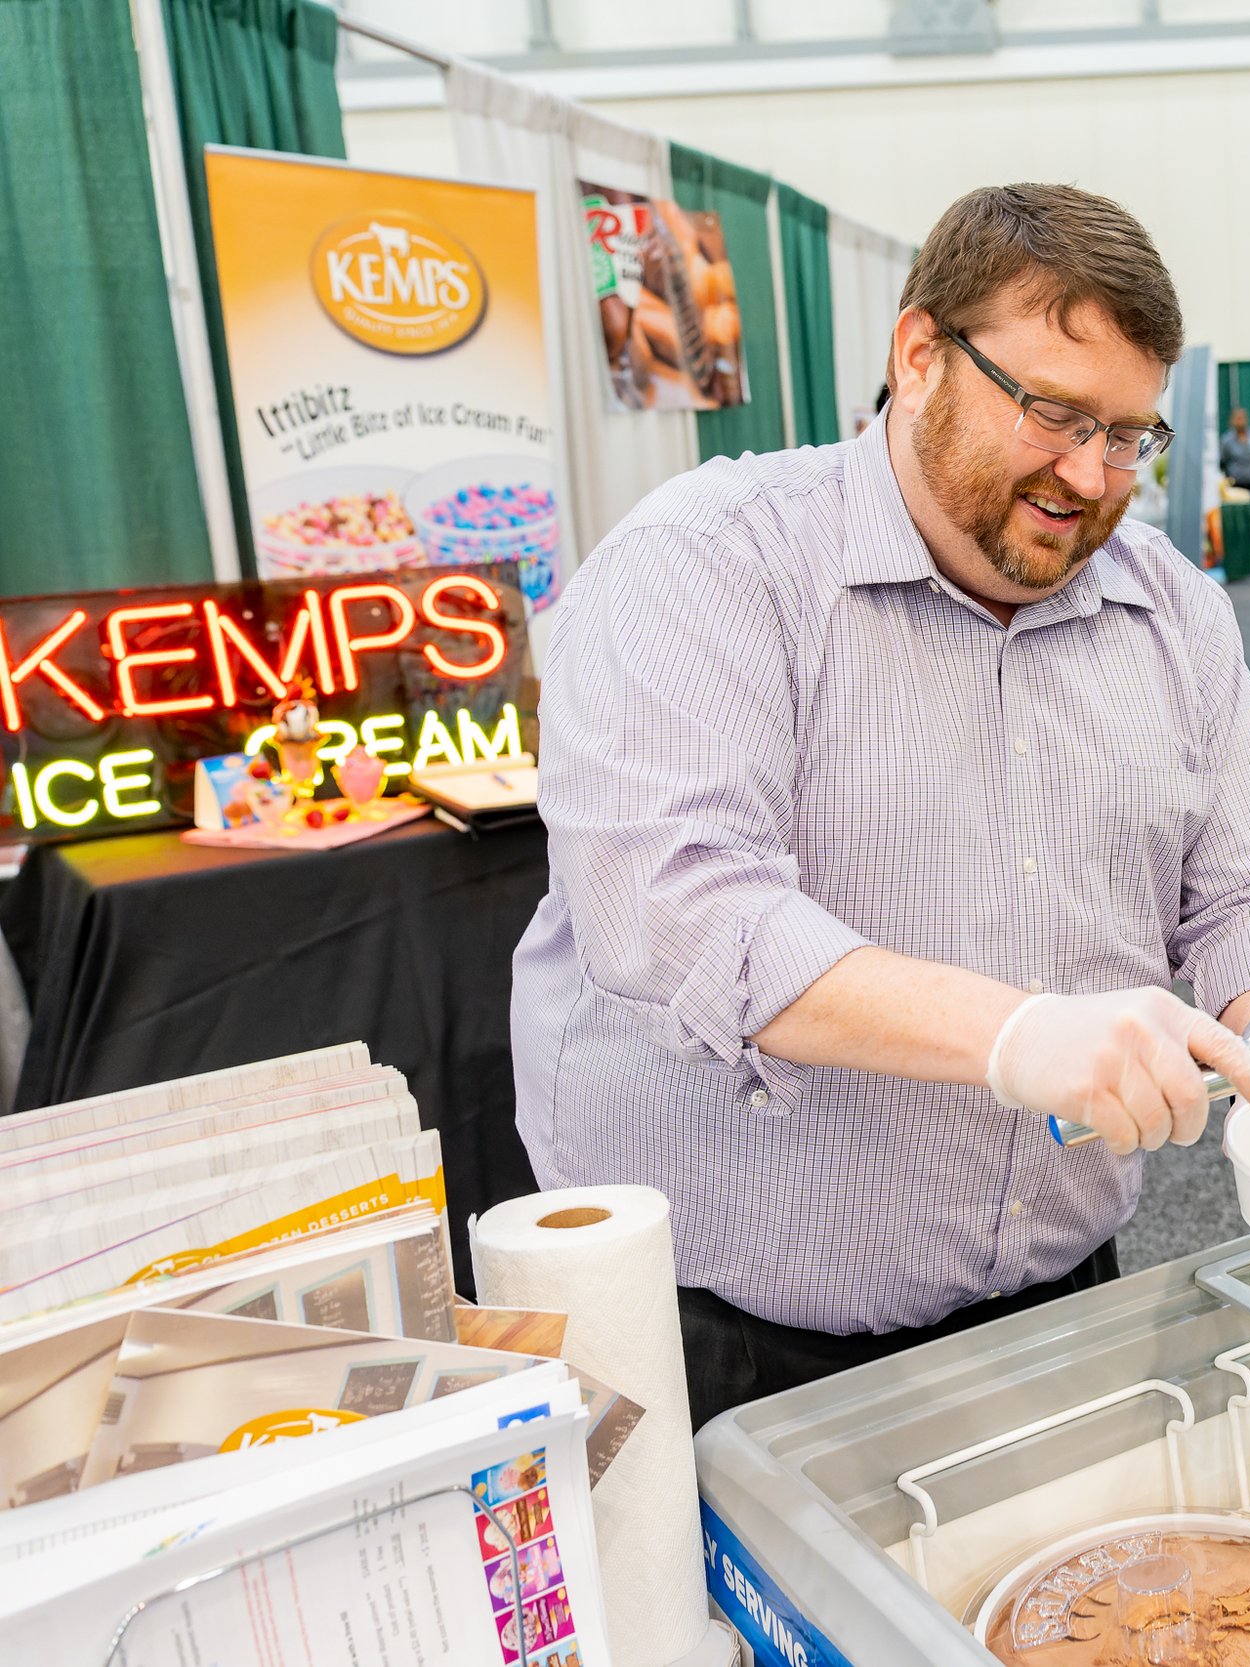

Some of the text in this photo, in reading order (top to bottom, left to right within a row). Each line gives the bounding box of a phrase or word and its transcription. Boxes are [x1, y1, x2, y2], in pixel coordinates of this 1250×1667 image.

[326, 248, 470, 311] KEMPS
[393, 403, 412, 428] of
[417, 404, 448, 427] Ice
[450, 402, 511, 434] Cream
[0, 573, 507, 732] KEMPS
[11, 748, 163, 830] ICE
[308, 1193, 389, 1233] DESSERTS
[721, 1553, 808, 1667] SERVING
